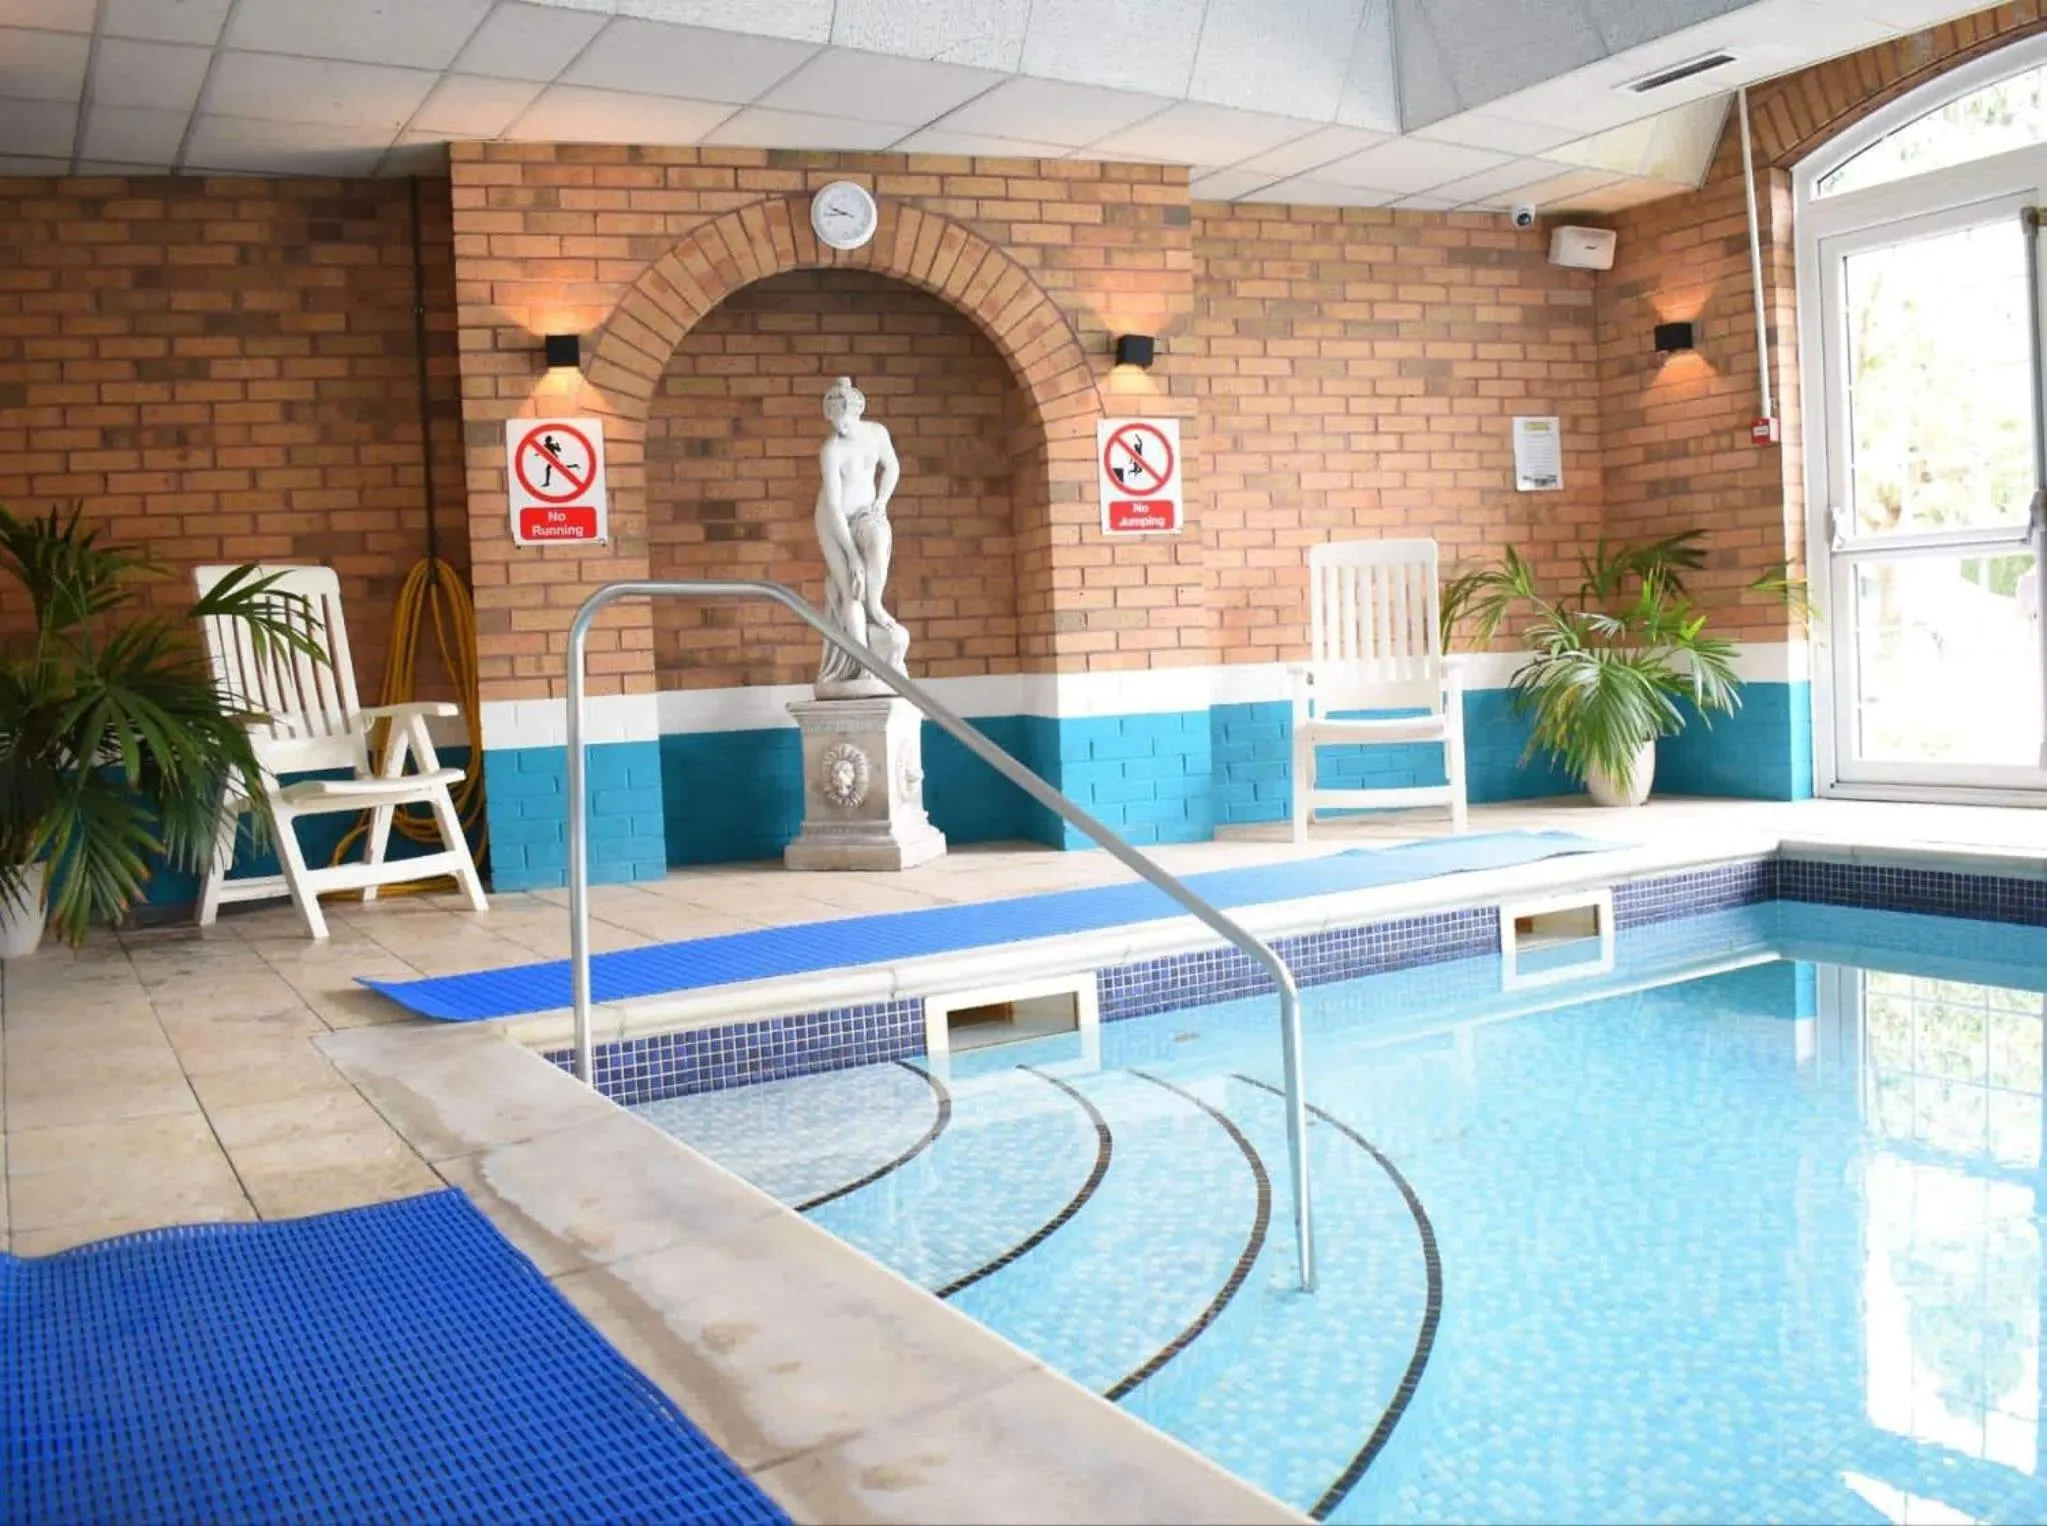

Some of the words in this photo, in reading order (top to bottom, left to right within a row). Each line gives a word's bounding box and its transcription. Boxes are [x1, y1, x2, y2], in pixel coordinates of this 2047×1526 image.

[1132, 502, 1150, 513] No
[547, 511, 567, 522] No
[1118, 515, 1166, 528] Jumping
[531, 524, 584, 537] Running
